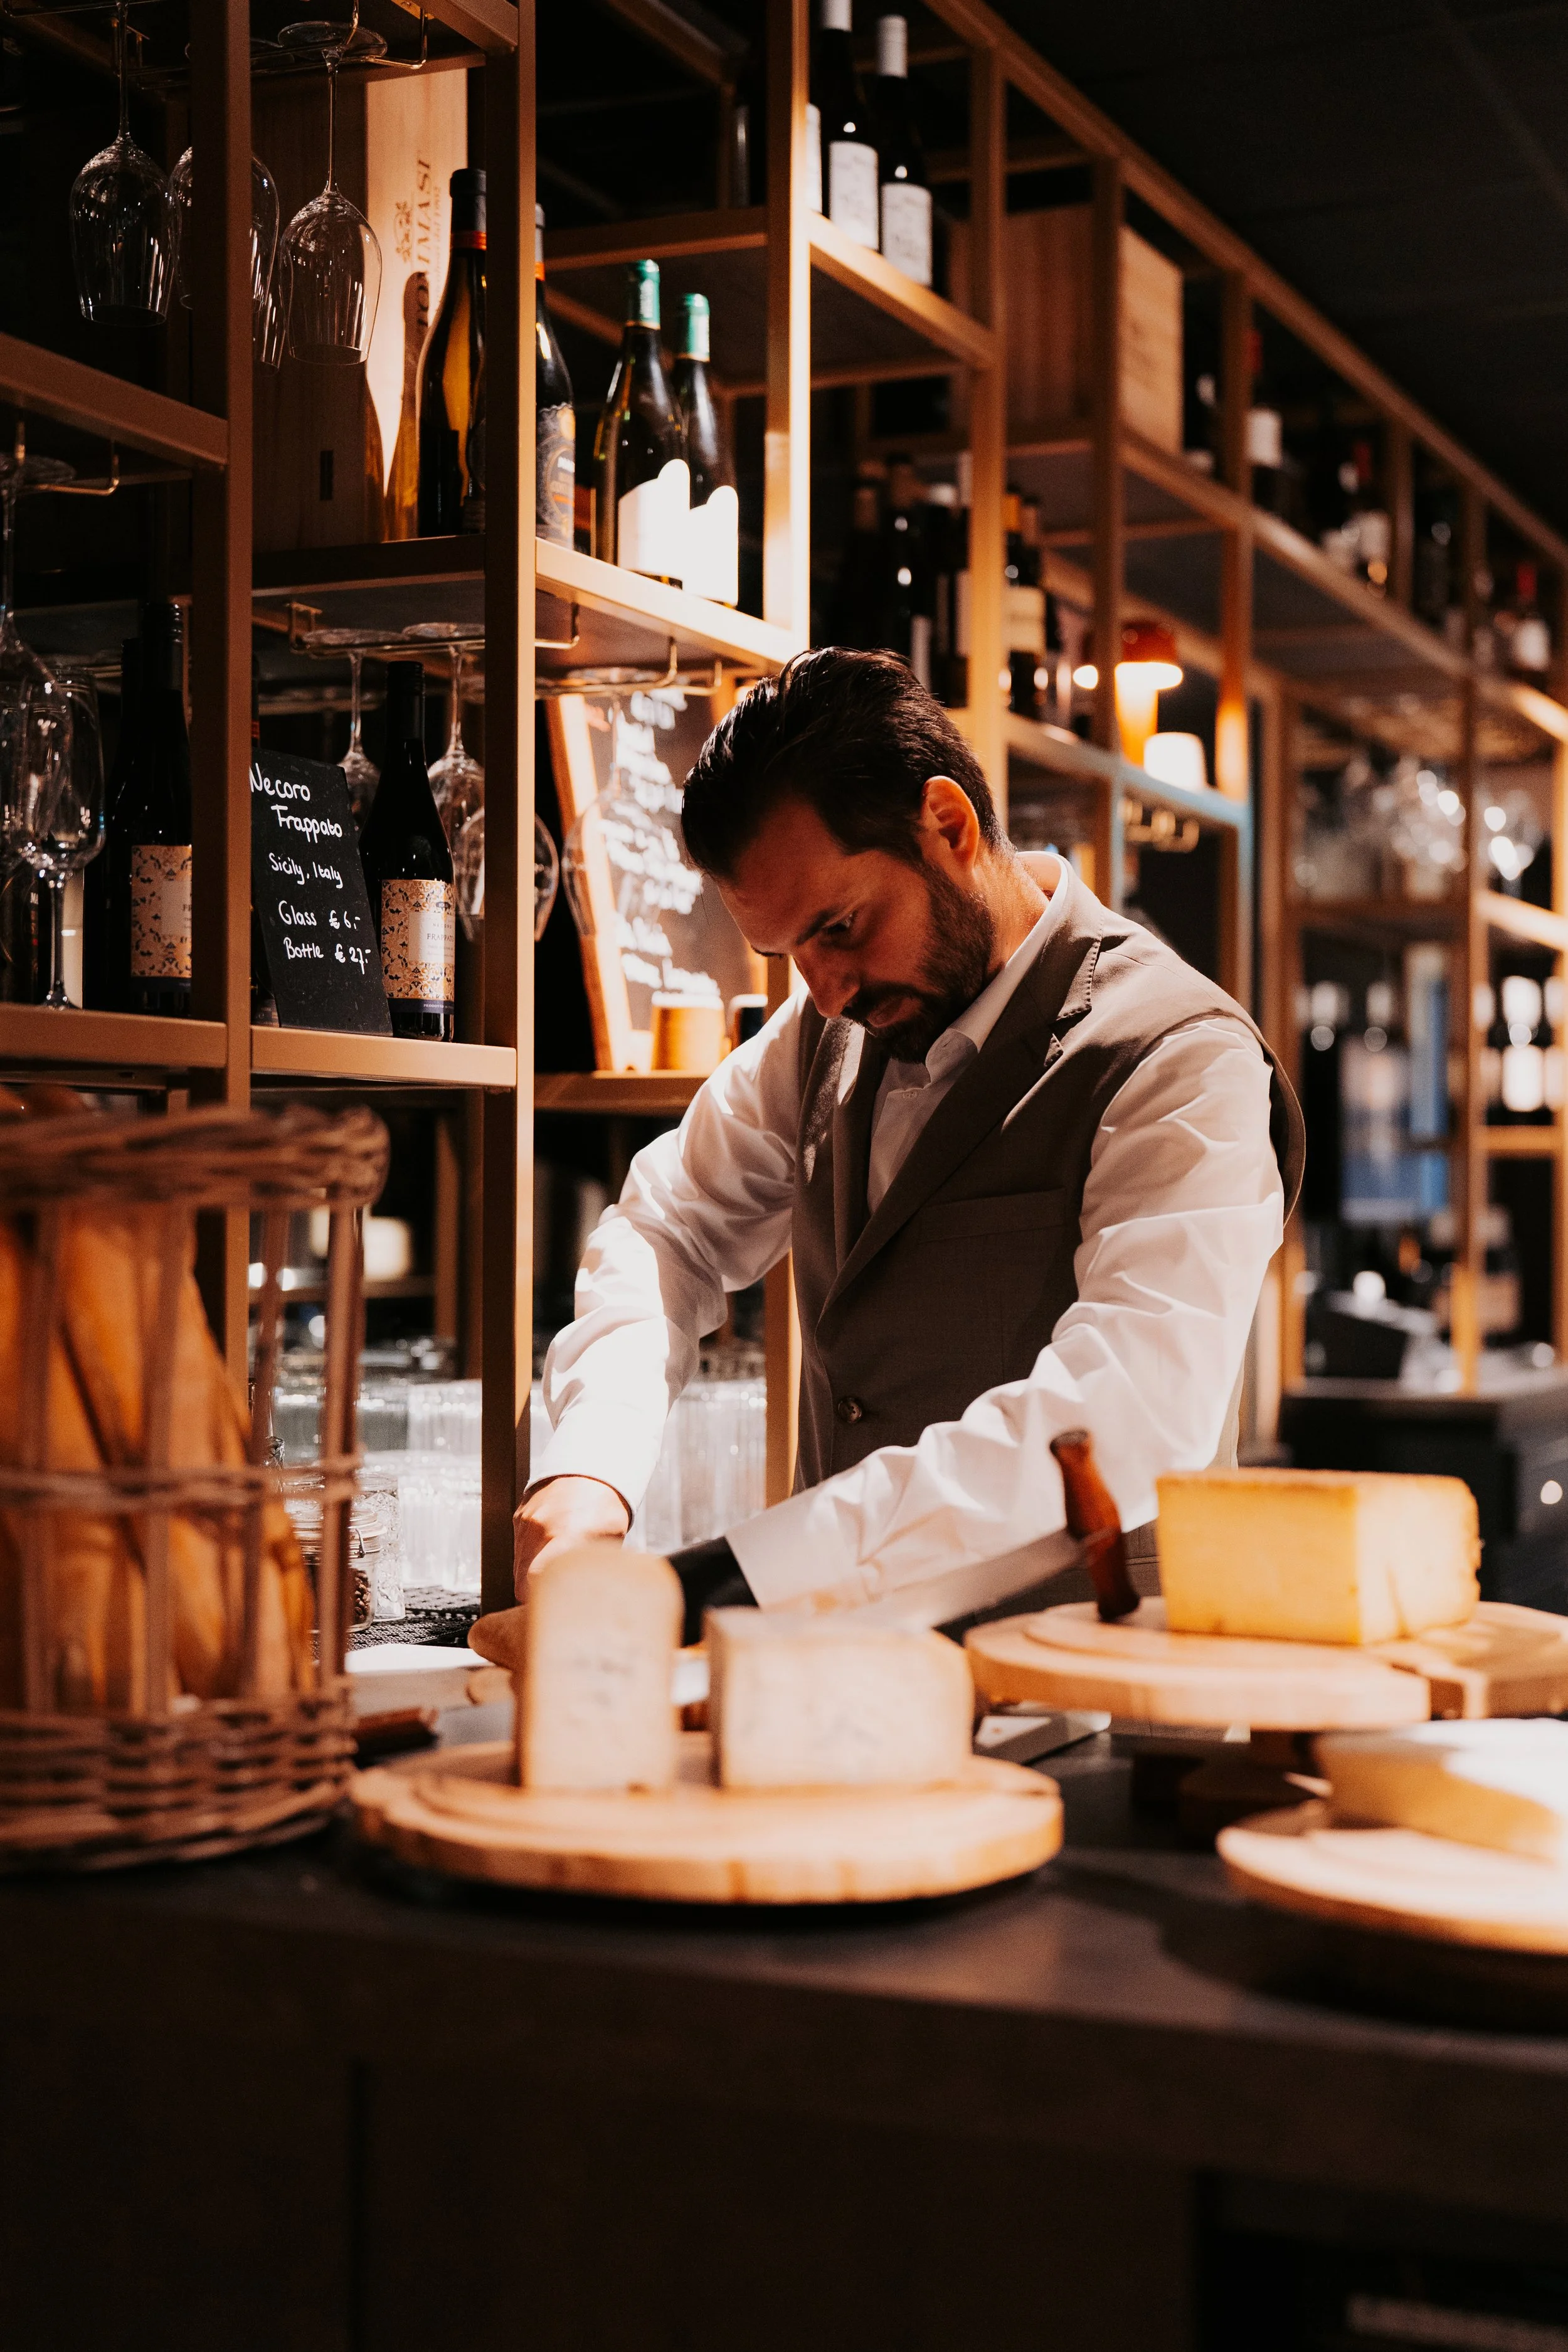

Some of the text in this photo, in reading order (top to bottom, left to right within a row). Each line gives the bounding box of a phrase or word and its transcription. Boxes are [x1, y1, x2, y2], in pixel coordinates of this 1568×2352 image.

[248, 763, 311, 802] Necoro
[270, 804, 343, 844] Frappato
[312, 861, 344, 889] Italy
[278, 900, 317, 926] Glass
[283, 937, 324, 960] Bottle
